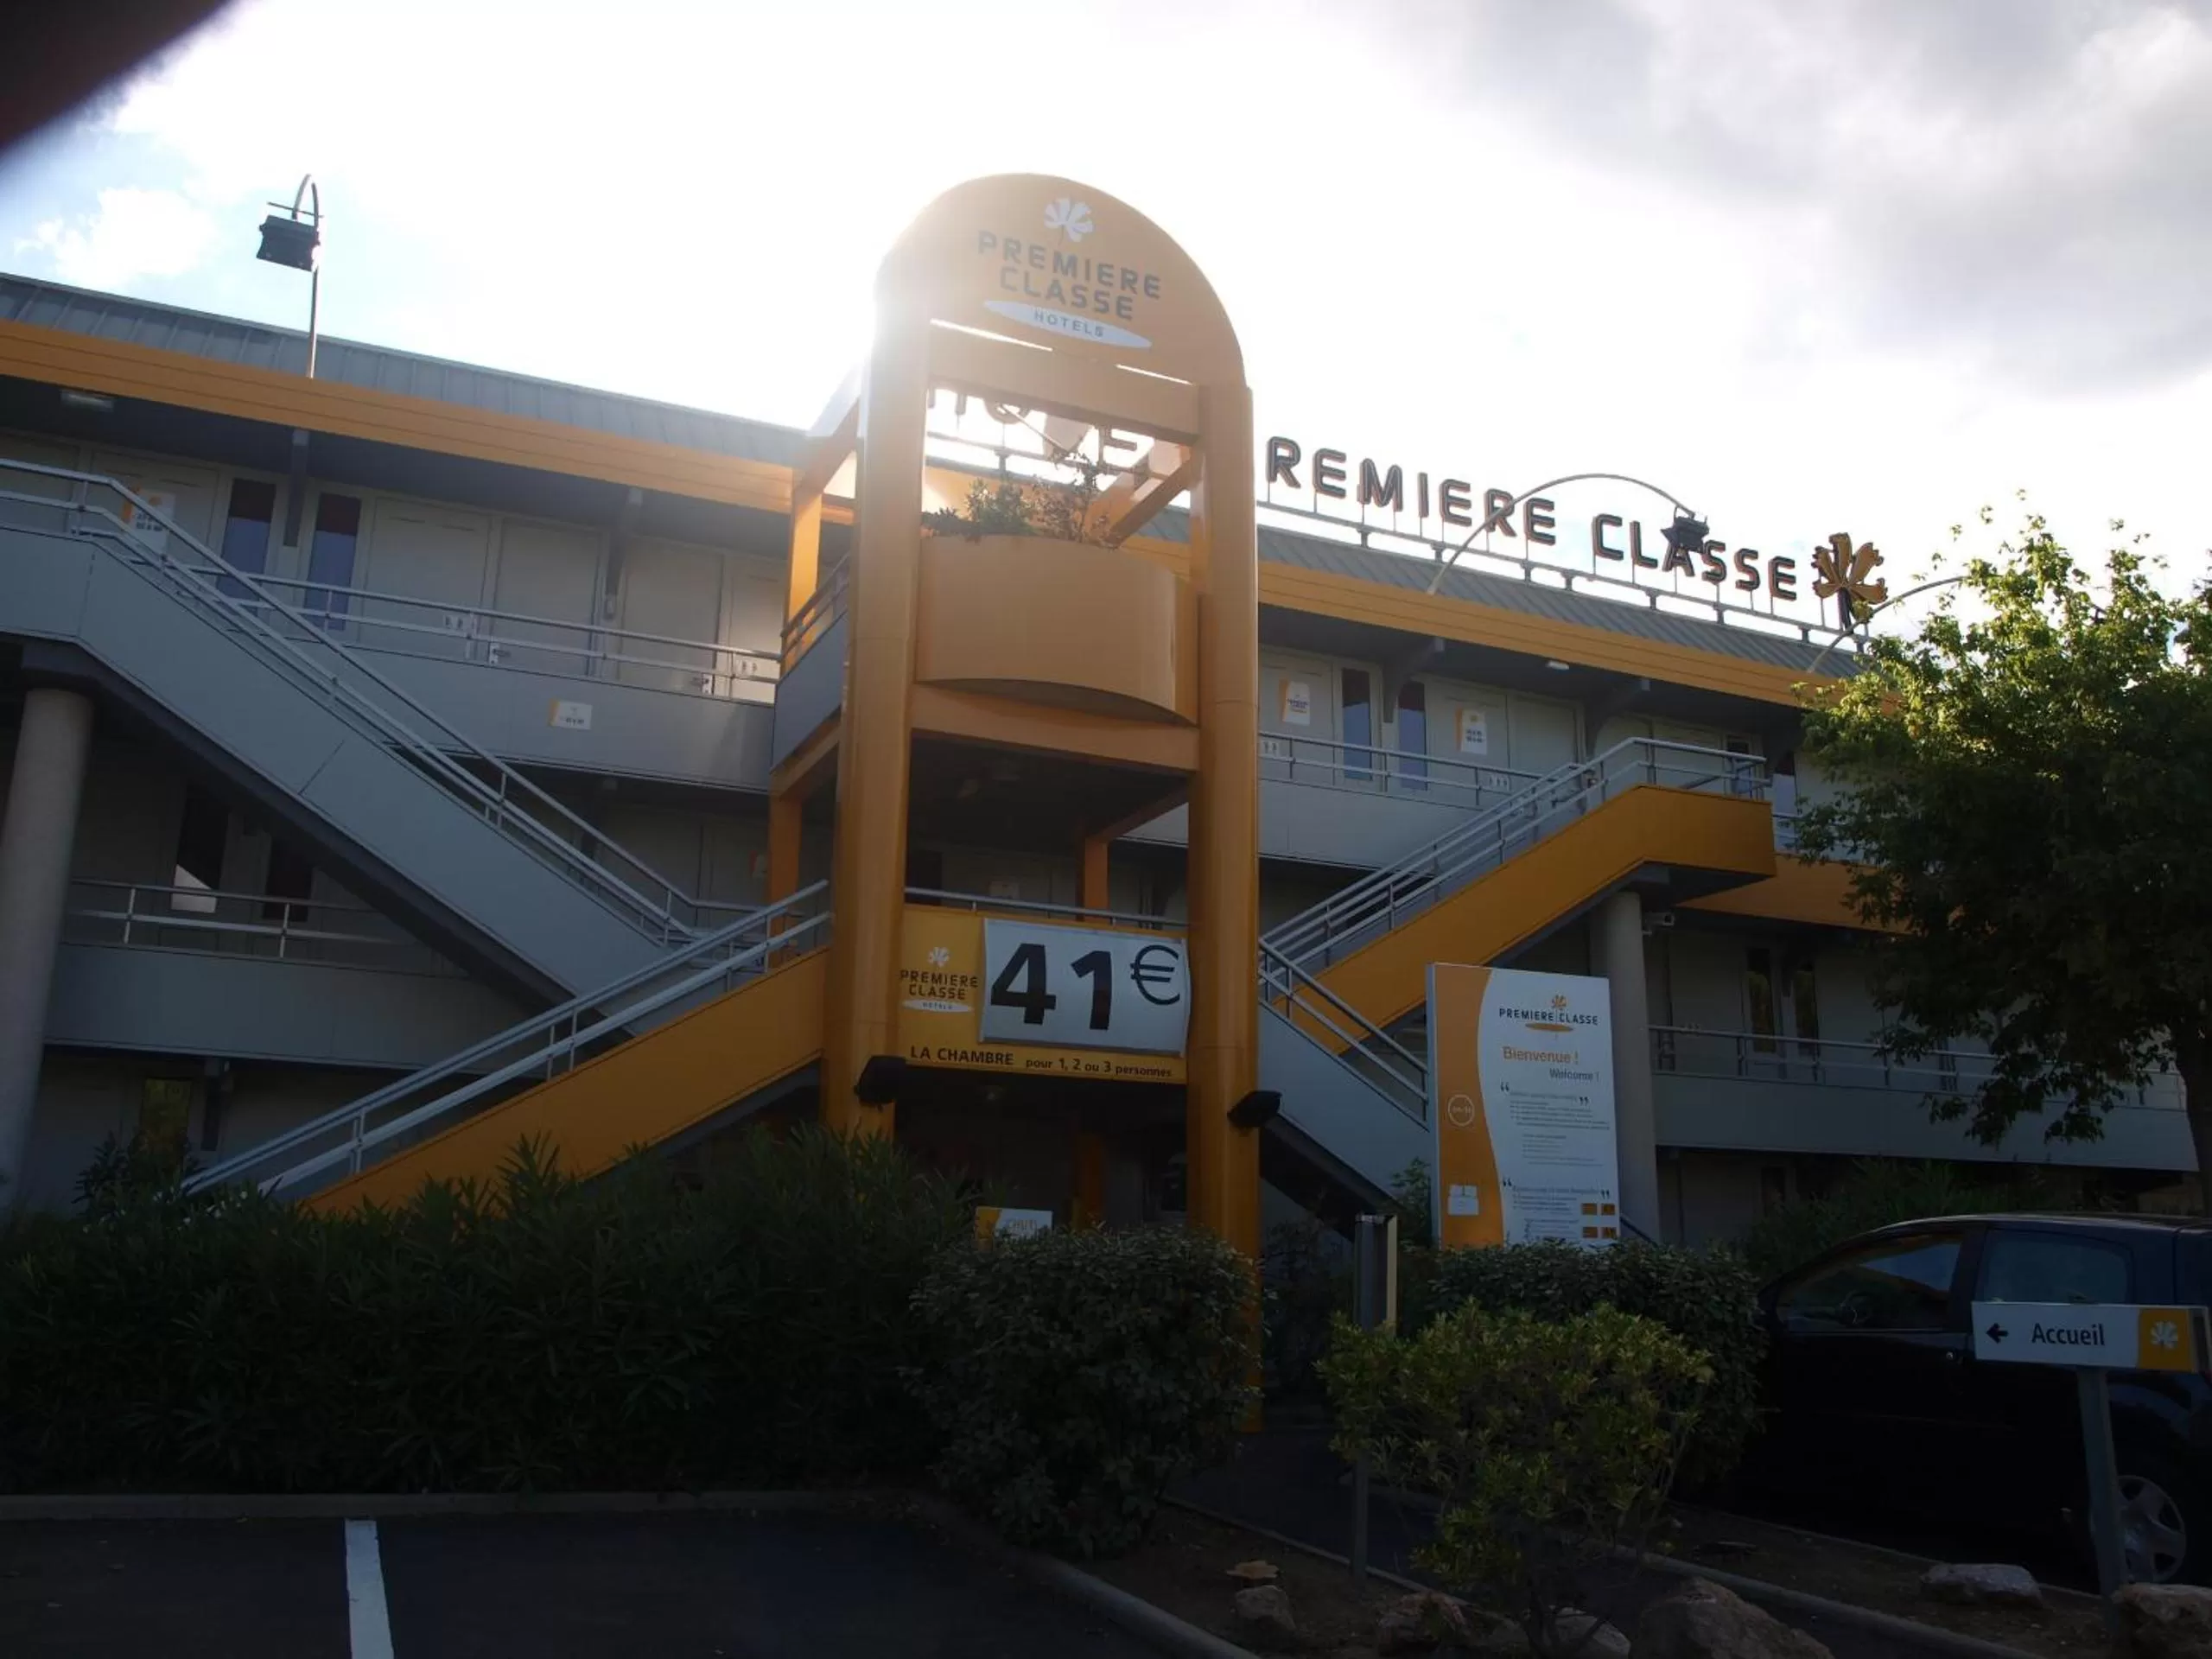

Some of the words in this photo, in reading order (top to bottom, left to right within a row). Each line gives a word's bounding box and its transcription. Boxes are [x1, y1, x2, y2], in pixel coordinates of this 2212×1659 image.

[977, 230, 1161, 300] PREMIERE
[1000, 265, 1134, 321] CLASSE
[1033, 310, 1105, 338] HOTELS
[1265, 435, 1556, 546] REMIERE
[899, 969, 979, 988] PREMIERE
[909, 983, 966, 1001] CLASSE
[1498, 1007, 1554, 1021] PREMIERE
[1559, 1013, 1599, 1026] CLASSE
[910, 1046, 931, 1060] LA
[938, 1047, 1014, 1065] CHAMBRE
[1026, 1059, 1053, 1071] pour
[1072, 1058, 1082, 1071] 2
[1084, 1062, 1100, 1072] ou
[1103, 1061, 1111, 1072] 3
[1116, 1065, 1172, 1078] personnes
[1503, 1046, 1572, 1064] Bienvenue
[2031, 1322, 2106, 1346] Accueil
